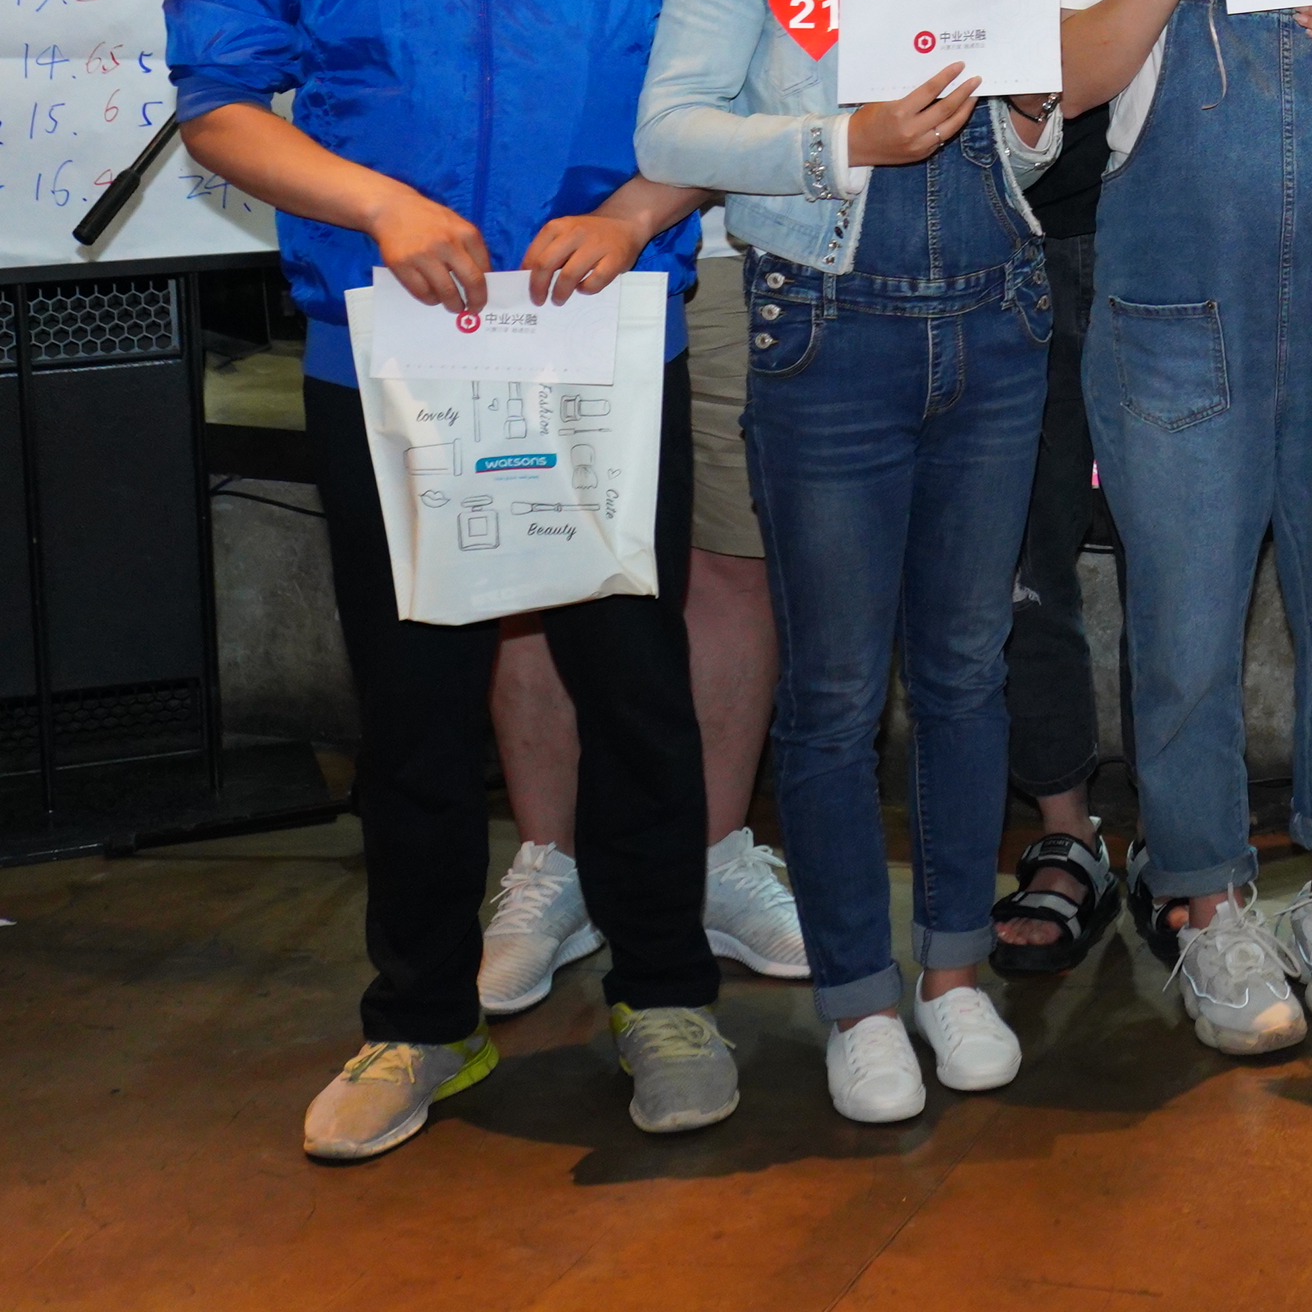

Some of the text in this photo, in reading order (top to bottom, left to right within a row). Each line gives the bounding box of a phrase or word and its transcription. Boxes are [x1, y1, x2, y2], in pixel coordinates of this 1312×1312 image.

[138, 51, 153, 74] 5
[104, 89, 120, 122] 6
[138, 101, 163, 127] 5
[484, 456, 548, 469] watsons
[604, 488, 620, 520] Cute
[526, 522, 578, 542] Beauty
